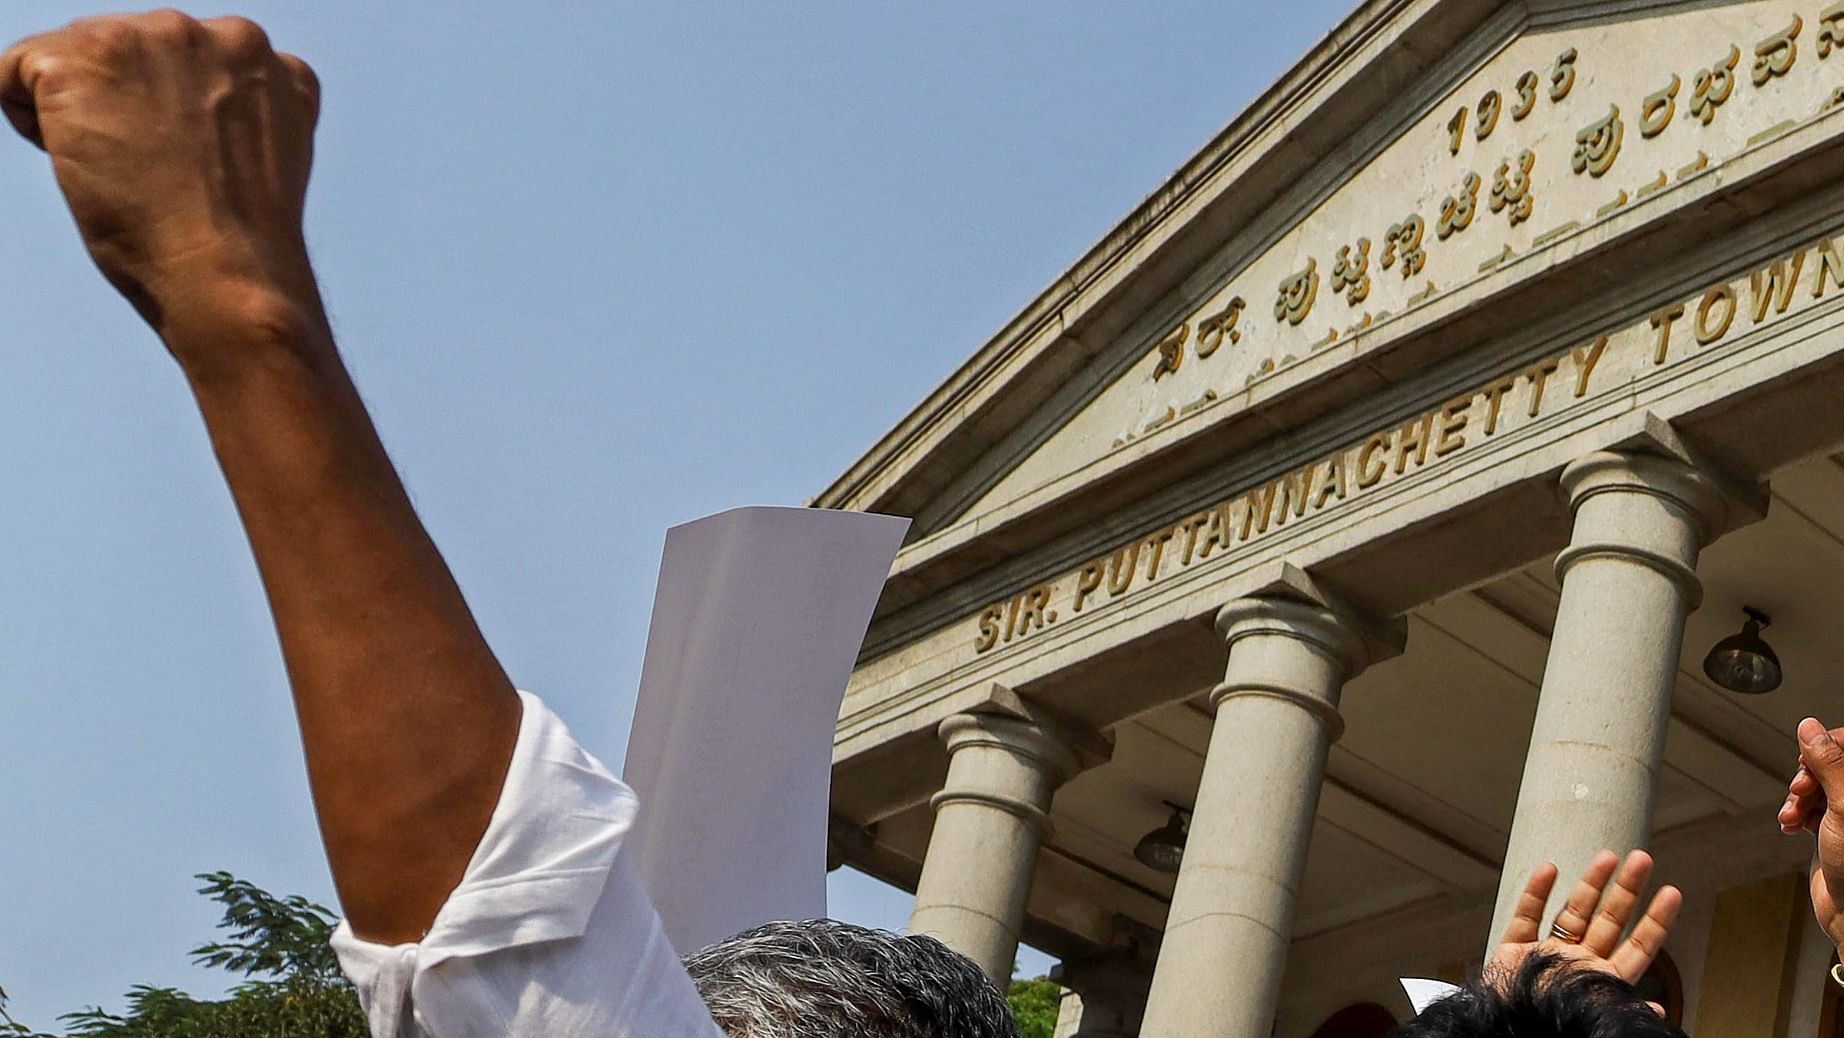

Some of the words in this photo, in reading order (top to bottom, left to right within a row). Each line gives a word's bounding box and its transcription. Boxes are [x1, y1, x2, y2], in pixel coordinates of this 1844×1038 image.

[1446, 46, 1578, 156] 1935
[1153, 295, 1246, 382] ಸರ್
[974, 580, 1058, 653] SIR.
[1073, 335, 1609, 611] PUTTANNACHETTY
